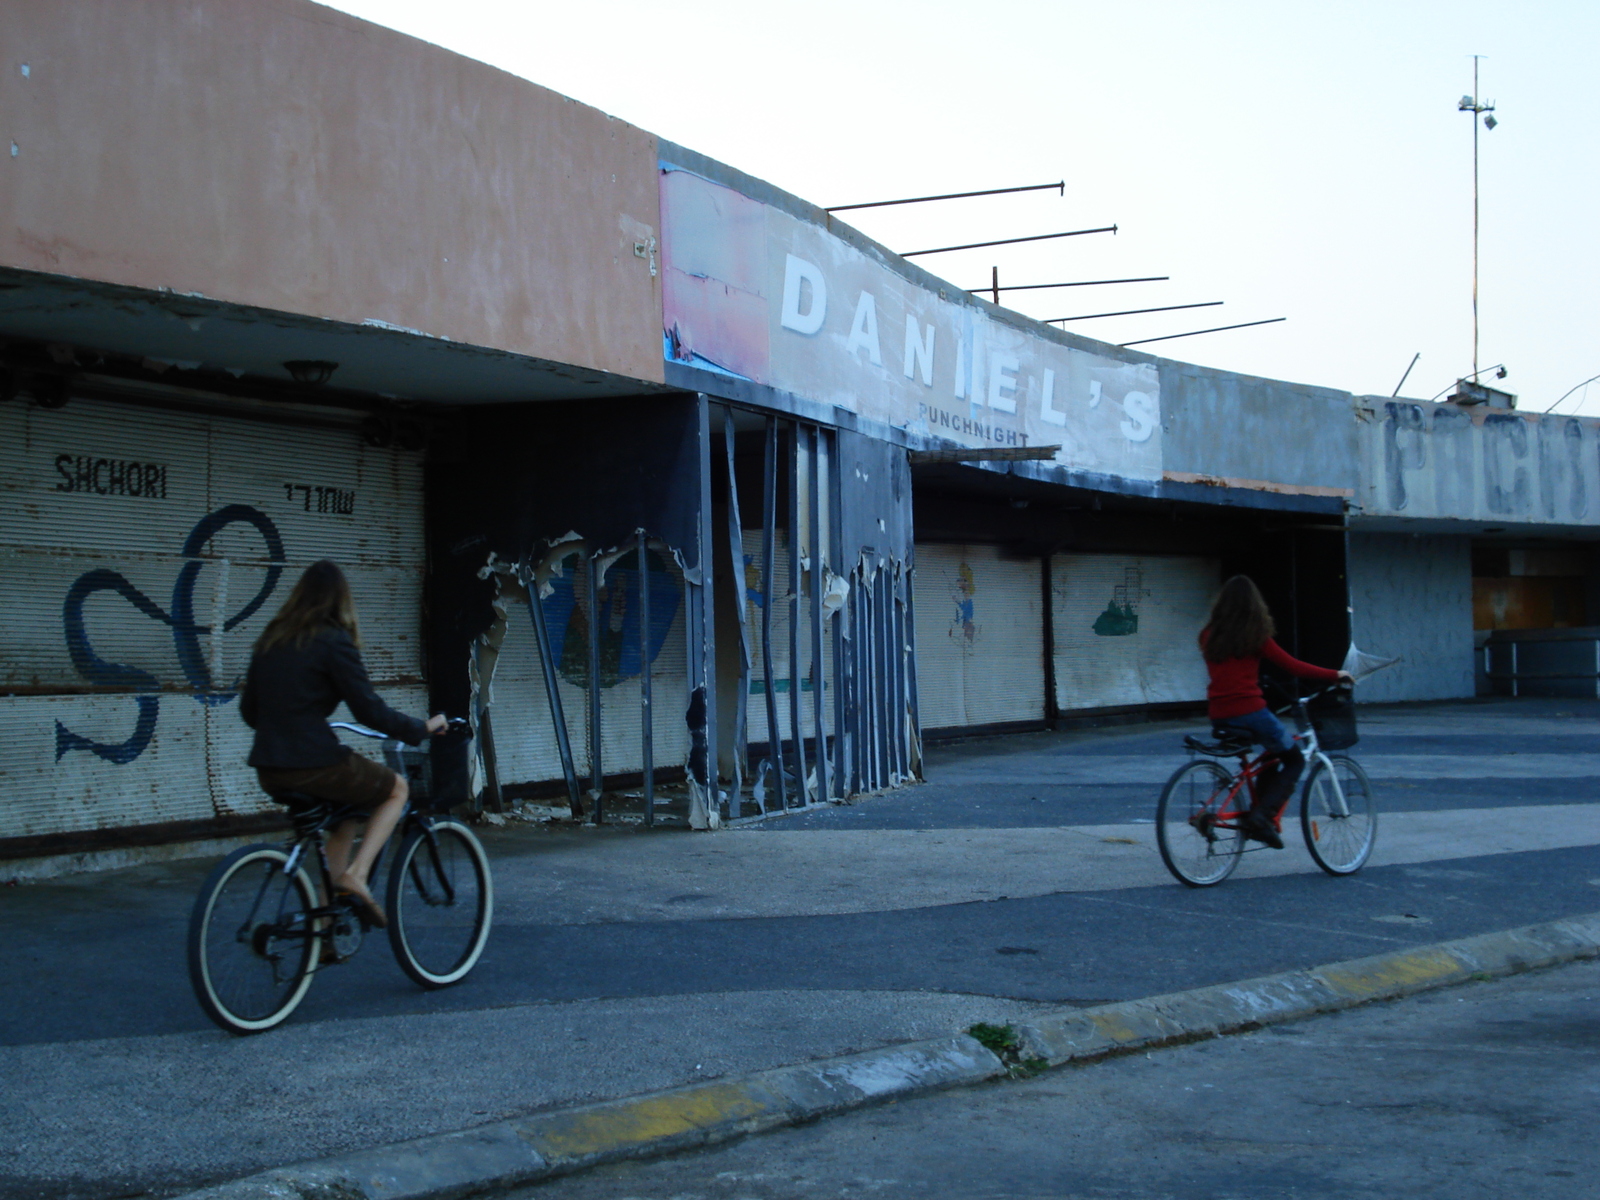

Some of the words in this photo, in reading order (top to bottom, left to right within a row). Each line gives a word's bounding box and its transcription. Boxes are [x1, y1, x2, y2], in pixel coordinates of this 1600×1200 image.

[780, 253, 1154, 442] DANIEL'S
[918, 401, 1029, 447] PUNCHNIGHT
[54, 453, 167, 499] SHCHORI
